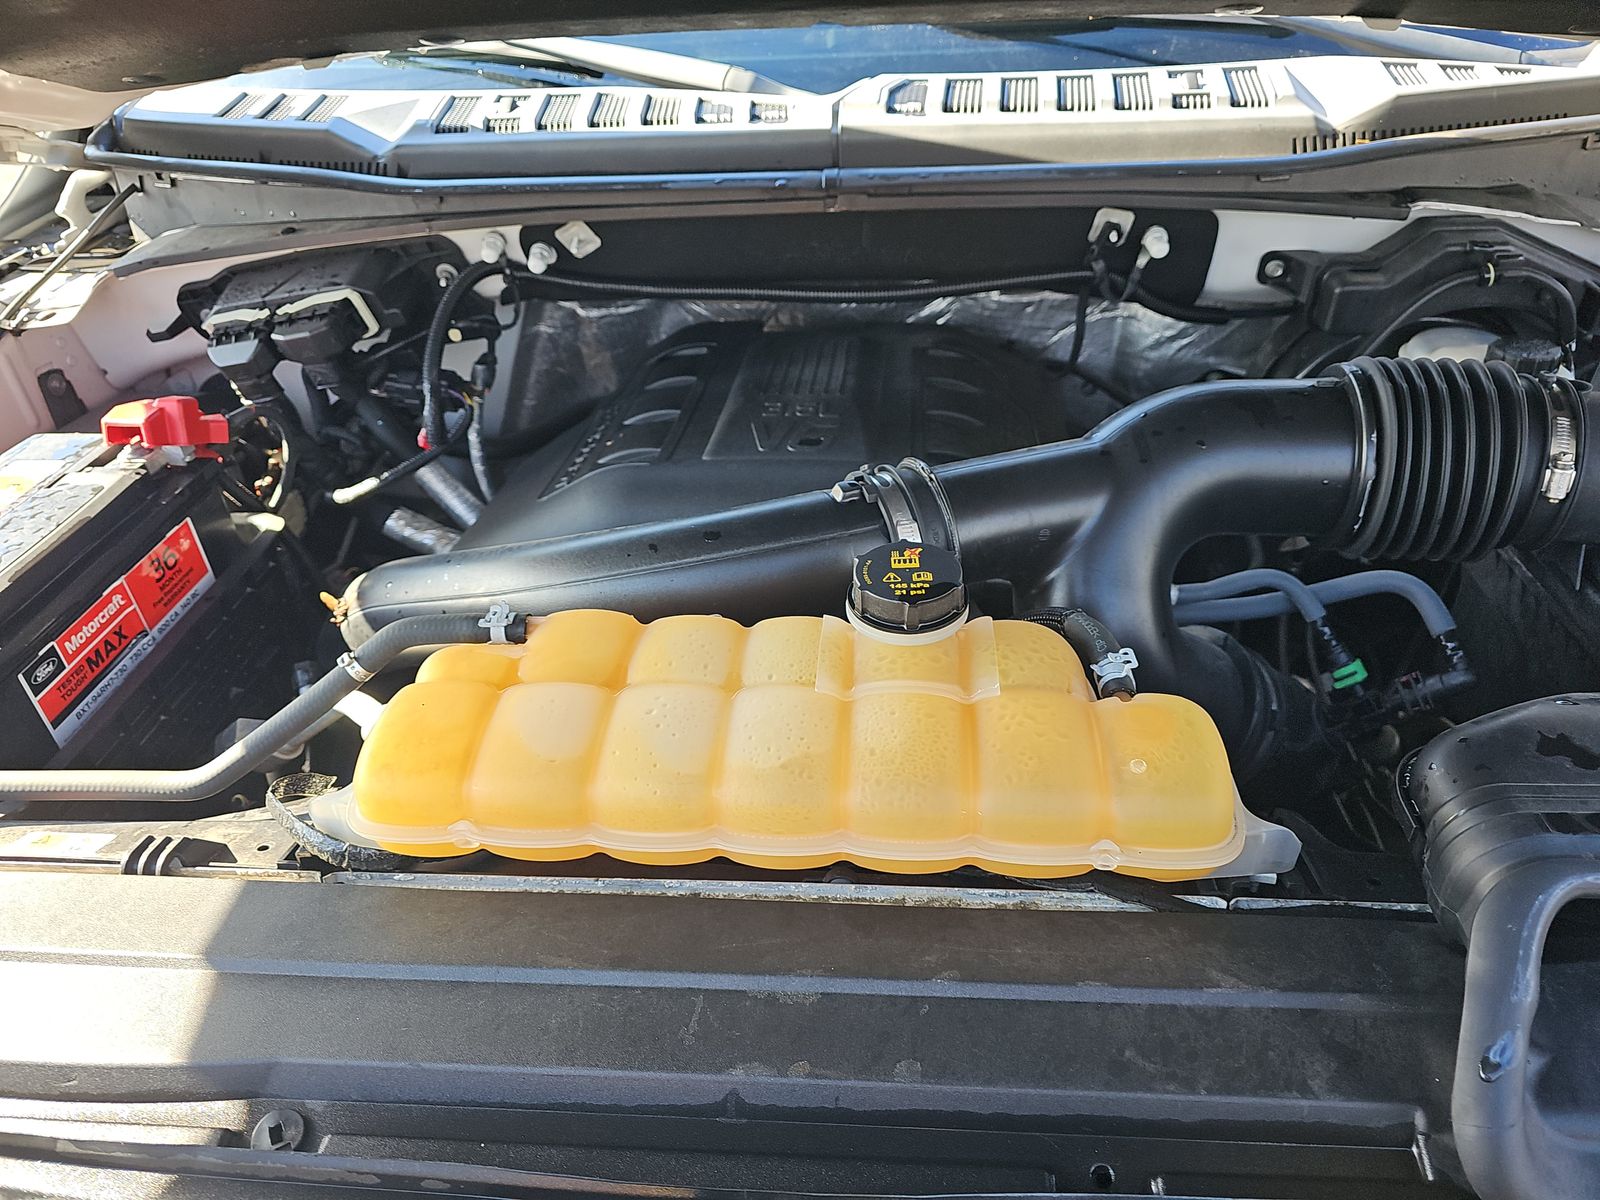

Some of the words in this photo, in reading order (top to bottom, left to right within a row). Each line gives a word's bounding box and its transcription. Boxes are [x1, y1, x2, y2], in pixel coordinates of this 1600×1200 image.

[149, 546, 178, 583] 36
[159, 568, 182, 591] MONTH
[64, 594, 126, 655] Motorcraft
[86, 625, 128, 673] MAX
[56, 664, 85, 693] TESTED
[61, 671, 88, 701] TOUGH
